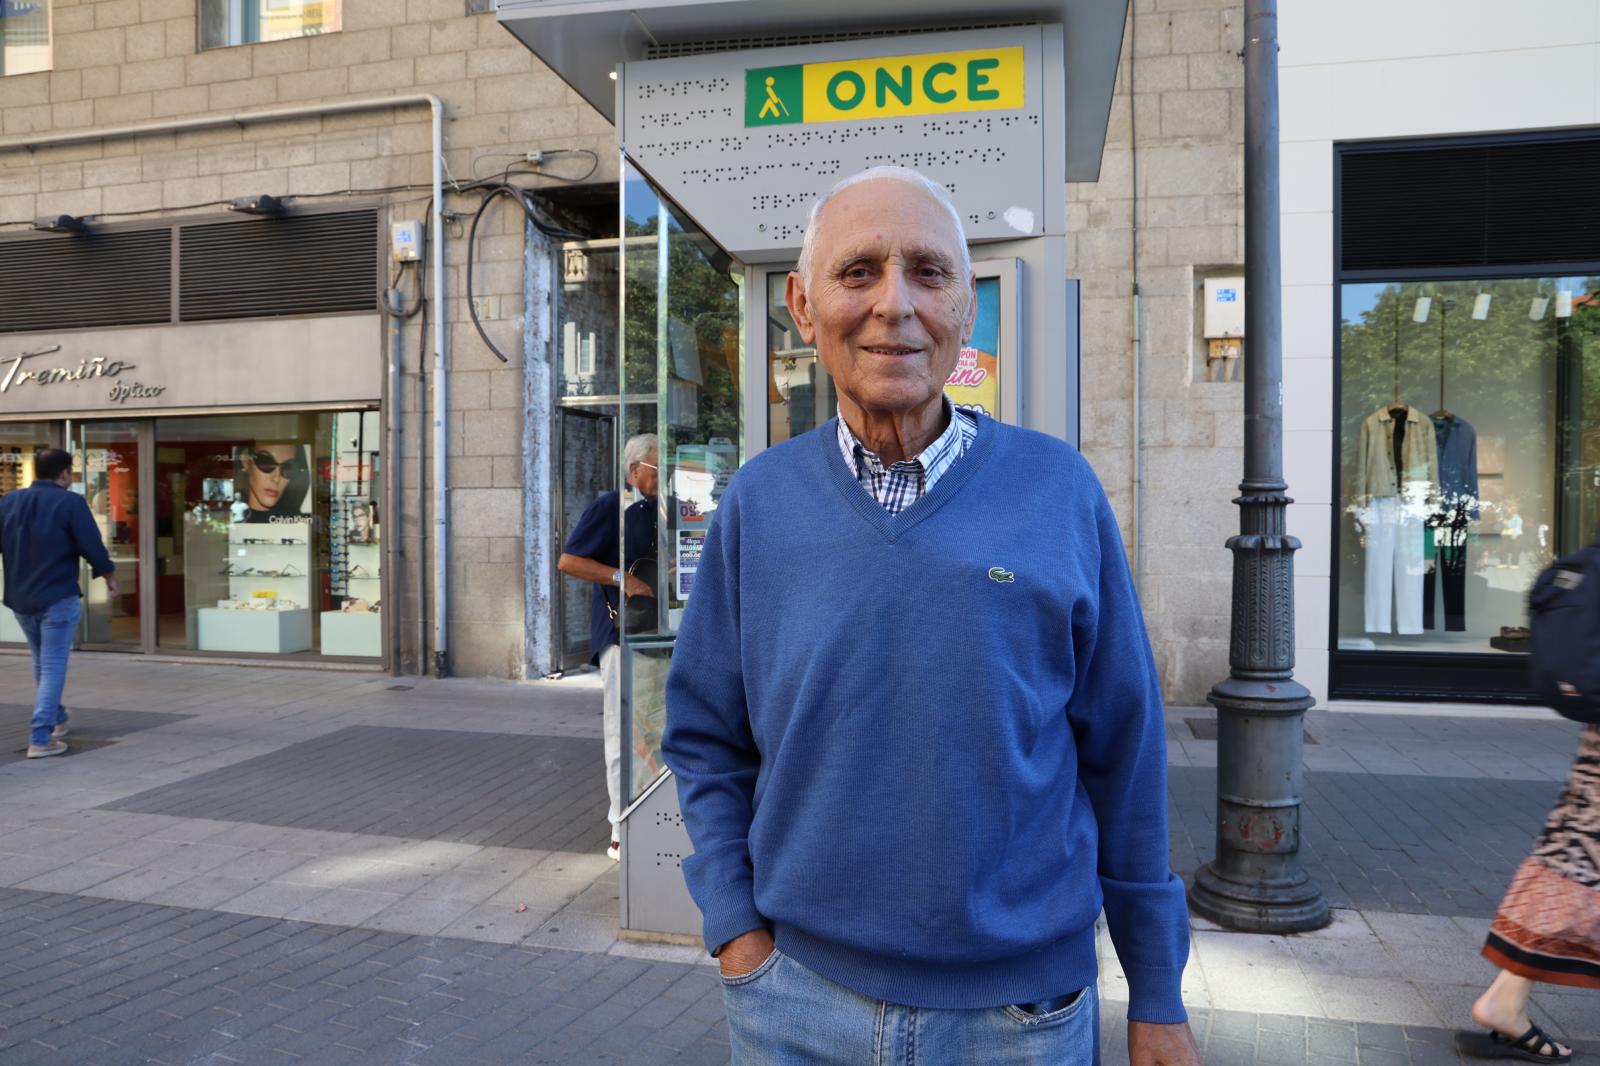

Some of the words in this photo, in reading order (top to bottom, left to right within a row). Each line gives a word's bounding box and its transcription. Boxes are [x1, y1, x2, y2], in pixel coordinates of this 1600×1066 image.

[826, 58, 1000, 111] ONCE
[0, 345, 136, 392] Tremiño
[109, 379, 166, 404] óptico
[269, 514, 294, 524] Calvin
[294, 514, 313, 525] Klein
